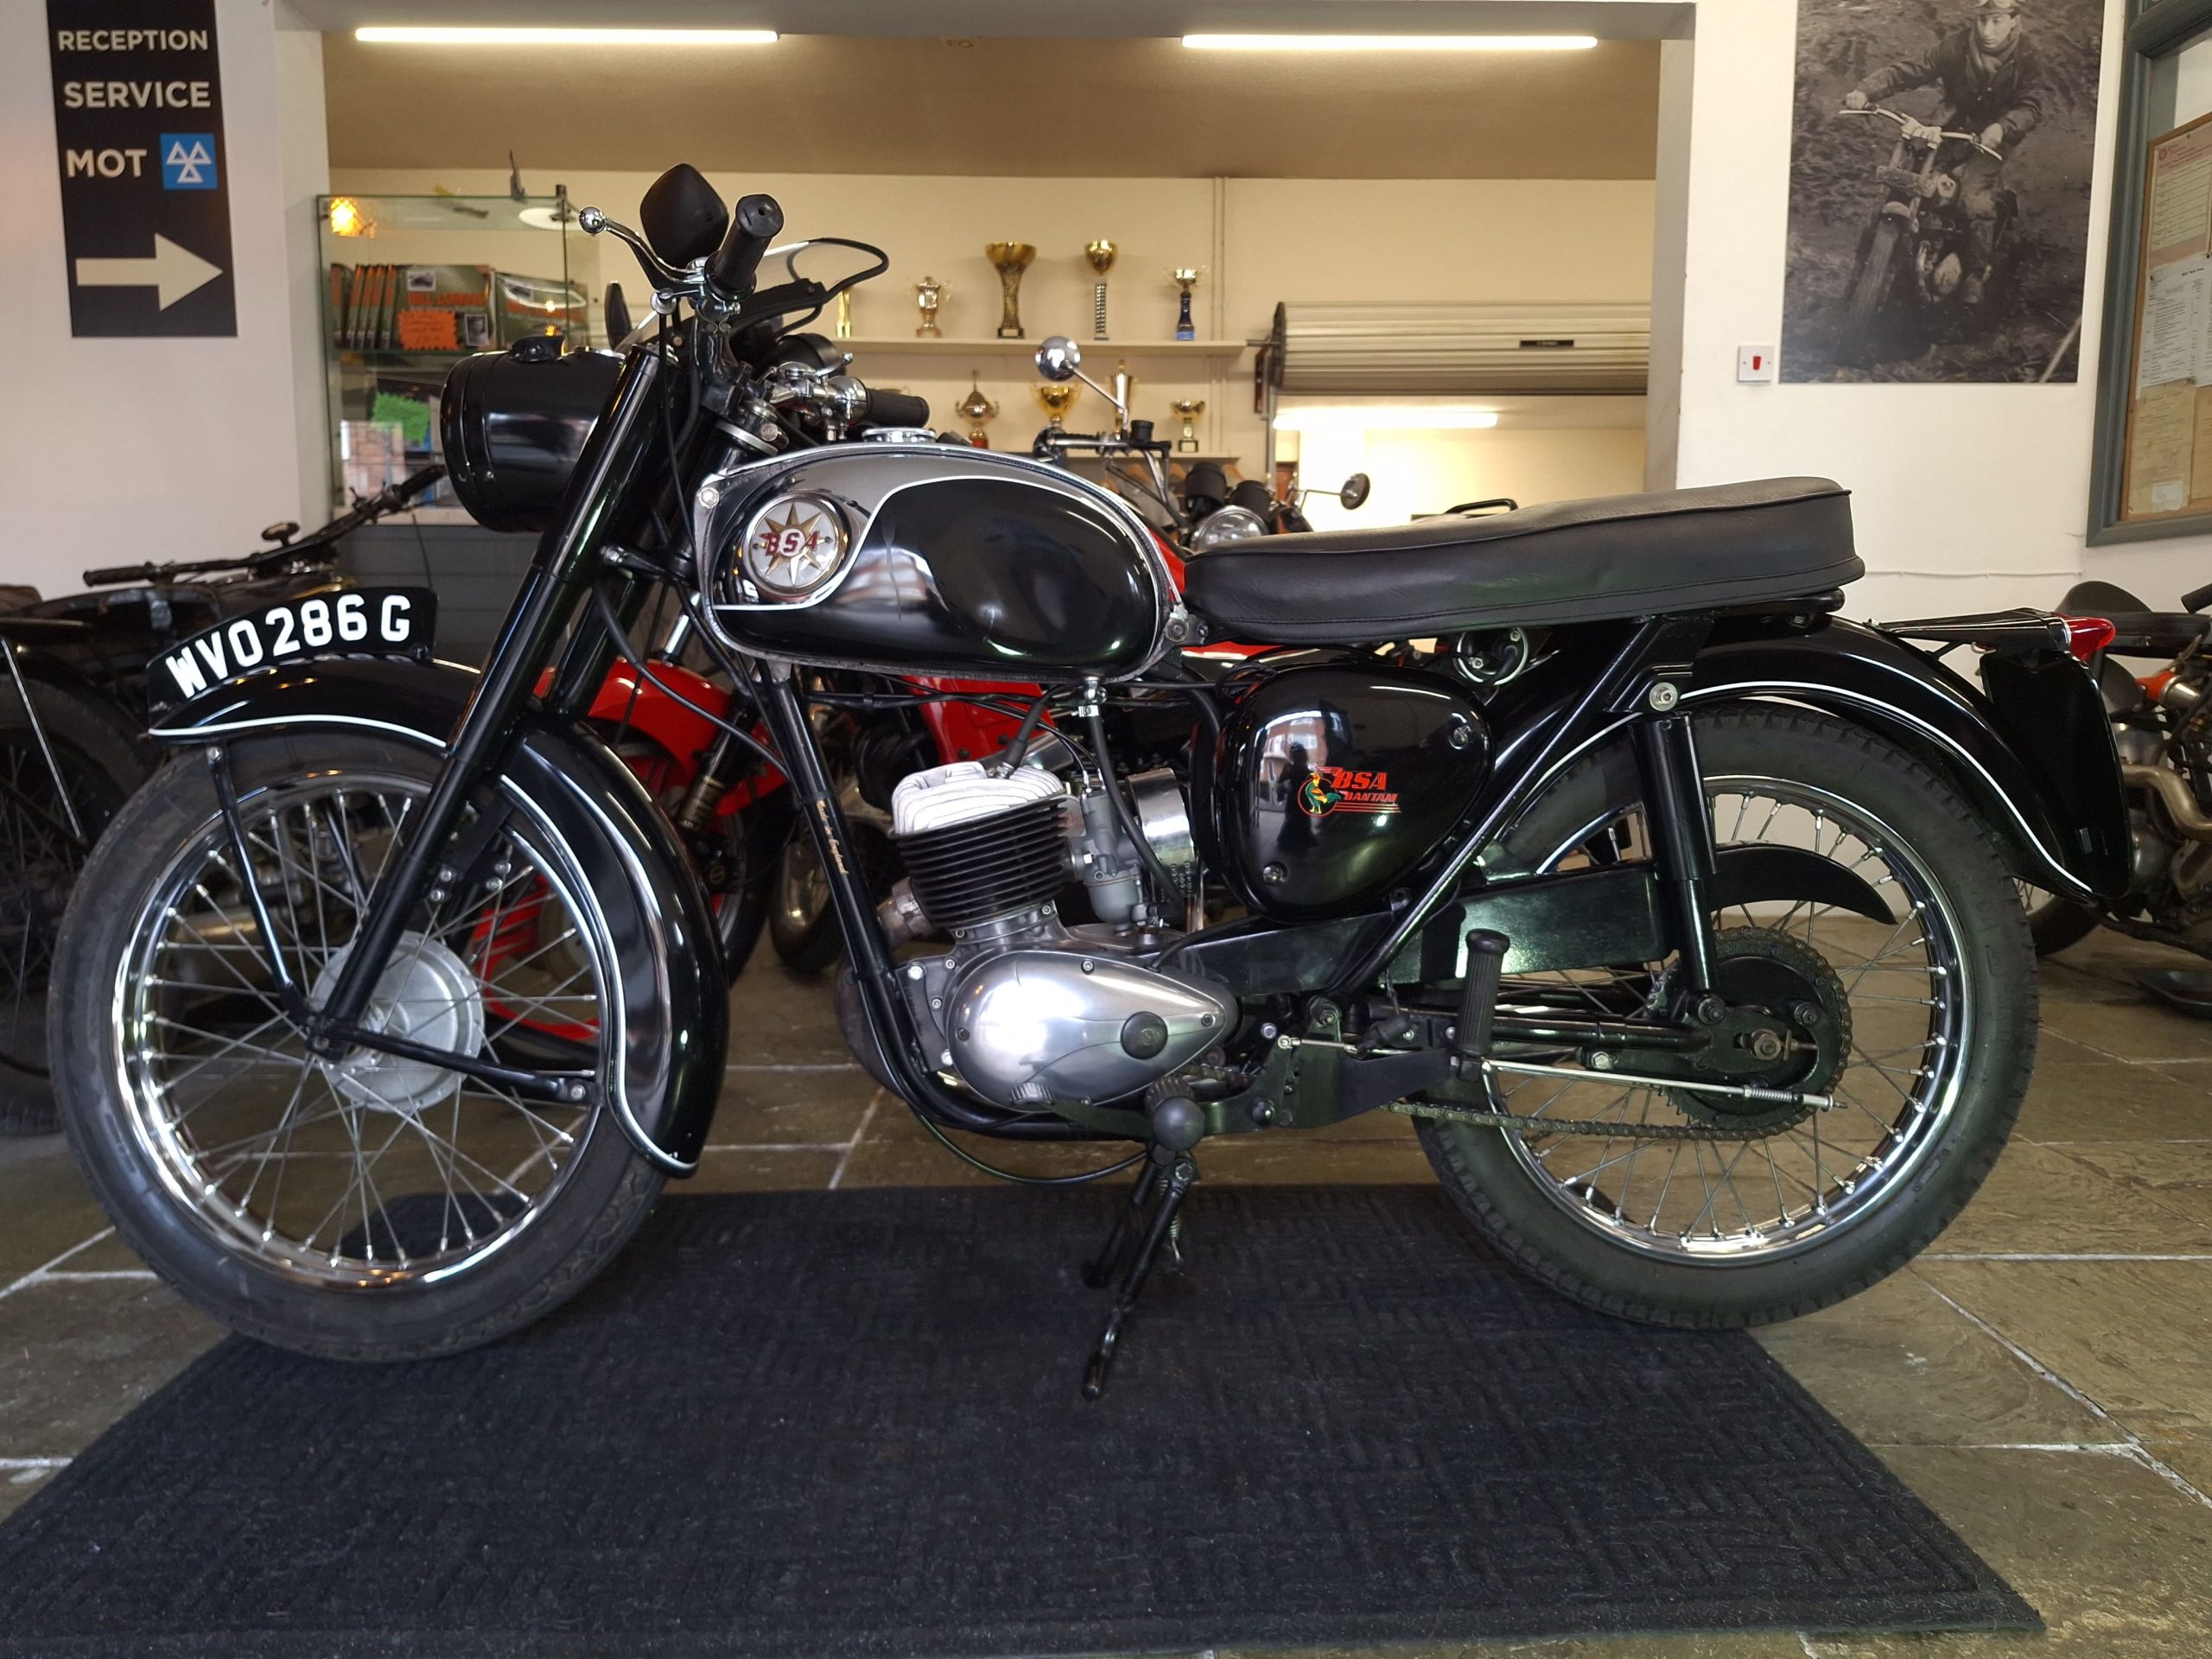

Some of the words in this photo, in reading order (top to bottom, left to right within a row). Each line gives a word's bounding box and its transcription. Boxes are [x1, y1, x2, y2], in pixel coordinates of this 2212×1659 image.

[58, 29, 209, 52] RECEPTION
[64, 81, 212, 109] SERVICE
[66, 149, 147, 178] MOT
[760, 531, 820, 556] BSA
[1330, 768, 1388, 790] BSA
[1343, 791, 1399, 803] BANTAM
